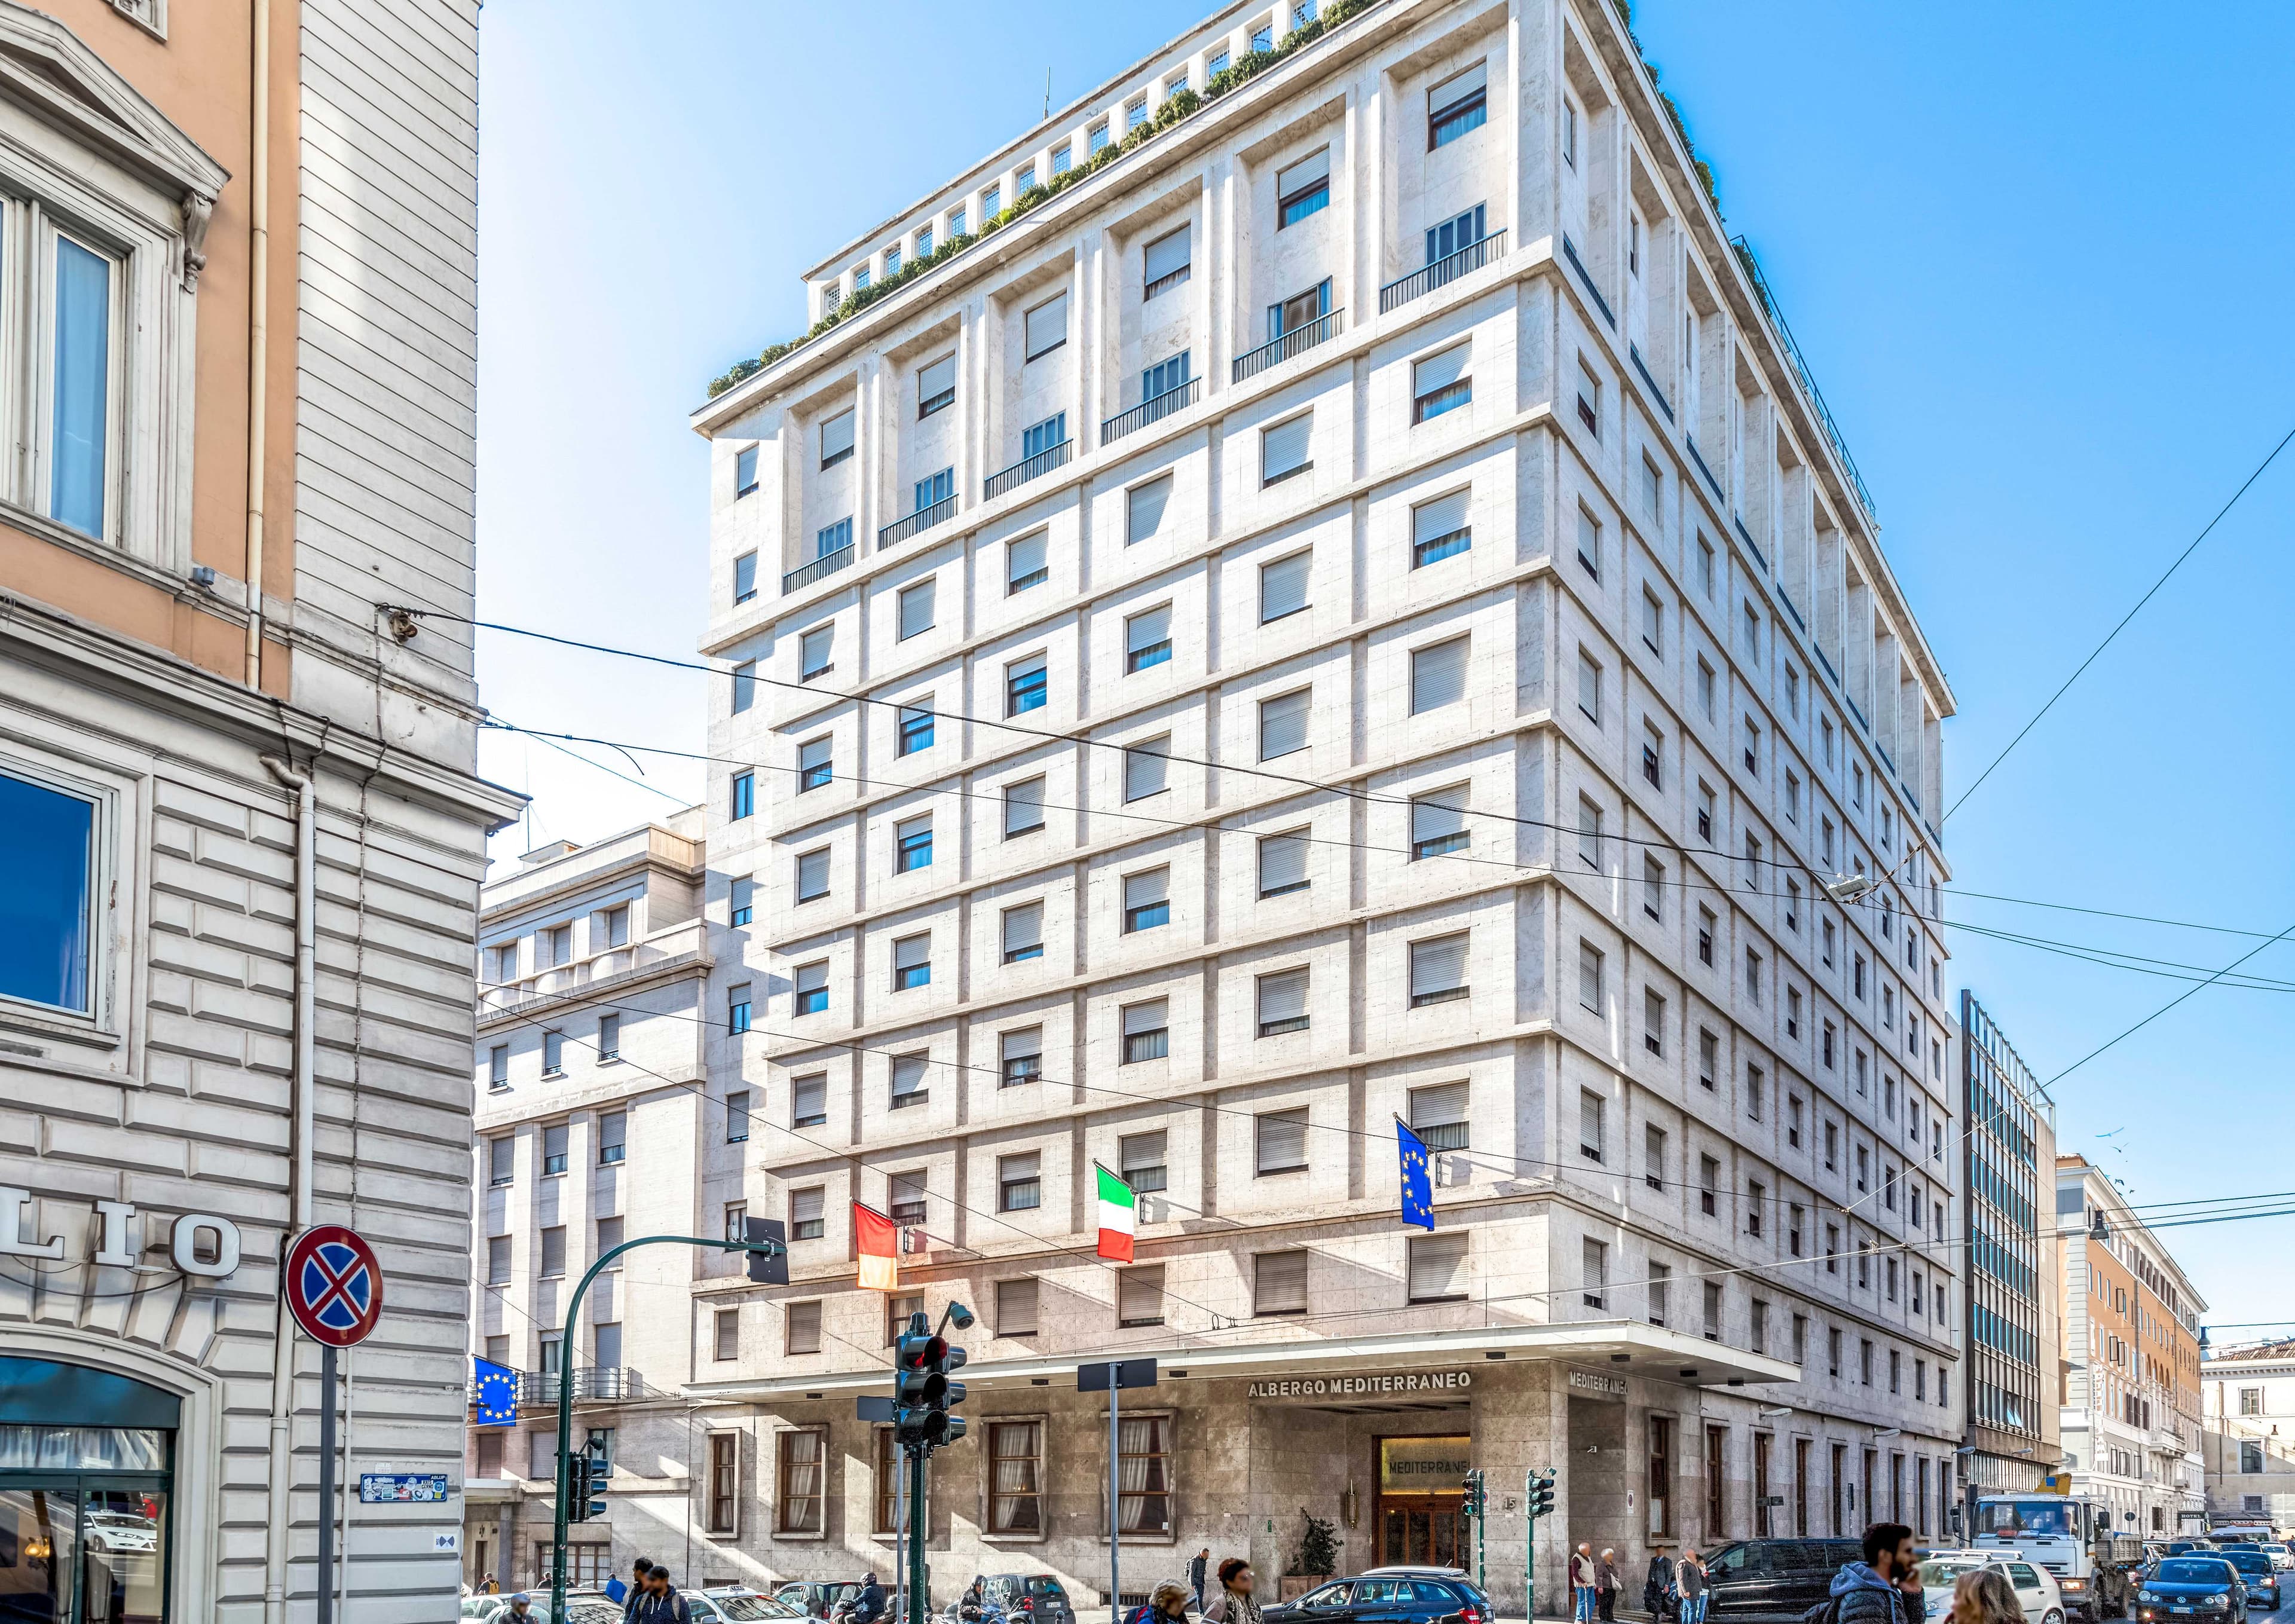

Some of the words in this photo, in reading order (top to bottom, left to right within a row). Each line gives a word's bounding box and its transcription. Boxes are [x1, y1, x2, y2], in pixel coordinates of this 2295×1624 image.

[0, 1186, 241, 1277] LIO
[1248, 1380, 1326, 1397] ALBERGO
[1330, 1372, 1471, 1393] MEDITERRANEO
[1389, 1461, 1470, 1474] MEDITERRANE
[1504, 1497, 1516, 1509] 15
